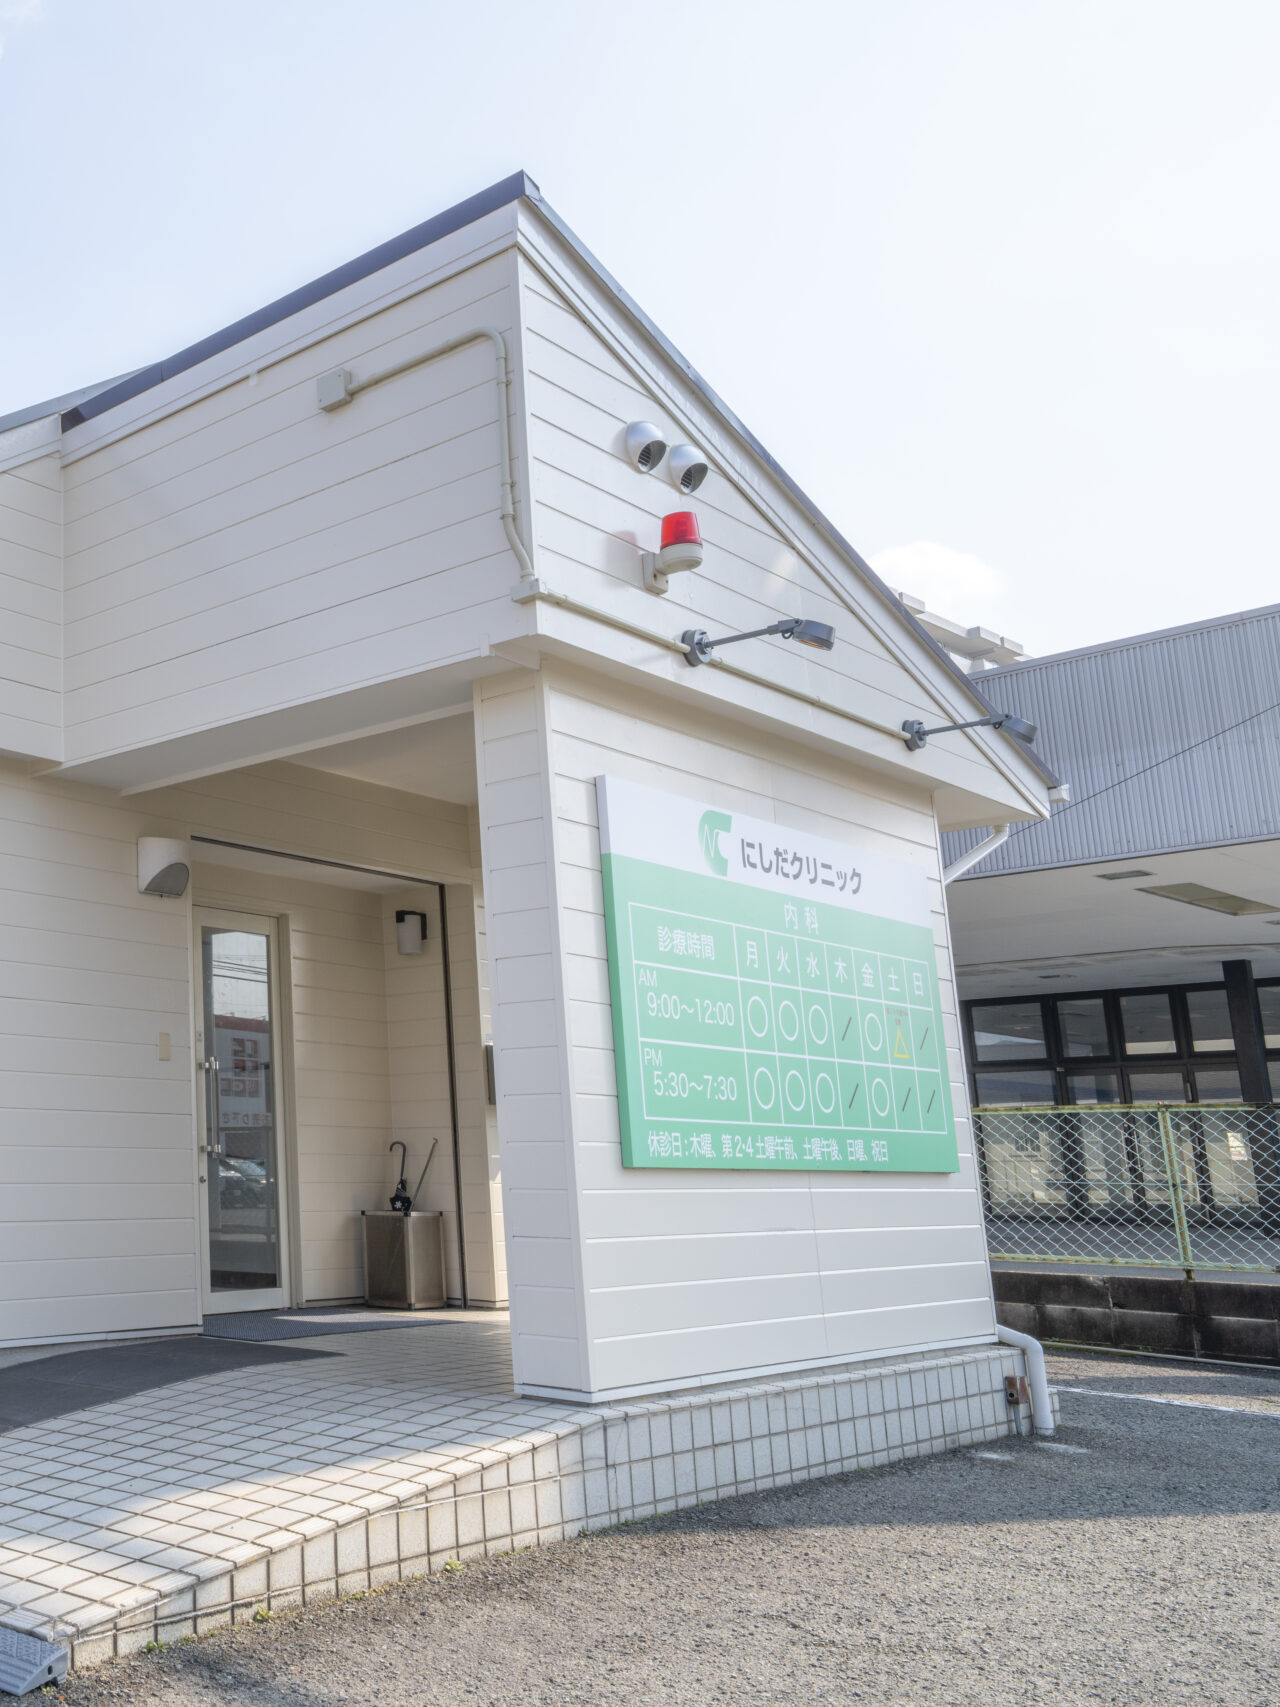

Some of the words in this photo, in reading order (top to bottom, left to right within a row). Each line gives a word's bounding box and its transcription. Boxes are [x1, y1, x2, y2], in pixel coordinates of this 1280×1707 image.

[740, 838, 863, 895] にしだクリニック
[784, 904, 819, 935] 内科
[638, 965, 657, 987] AM
[657, 926, 715, 961] 診療時間
[746, 941, 759, 969] 月
[776, 948, 792, 974] 火
[806, 952, 821, 978] 水
[834, 957, 848, 983] 木
[861, 962, 875, 988] 金
[888, 969, 901, 992] 土
[913, 975, 923, 996] 日
[644, 1047, 662, 1066] PM
